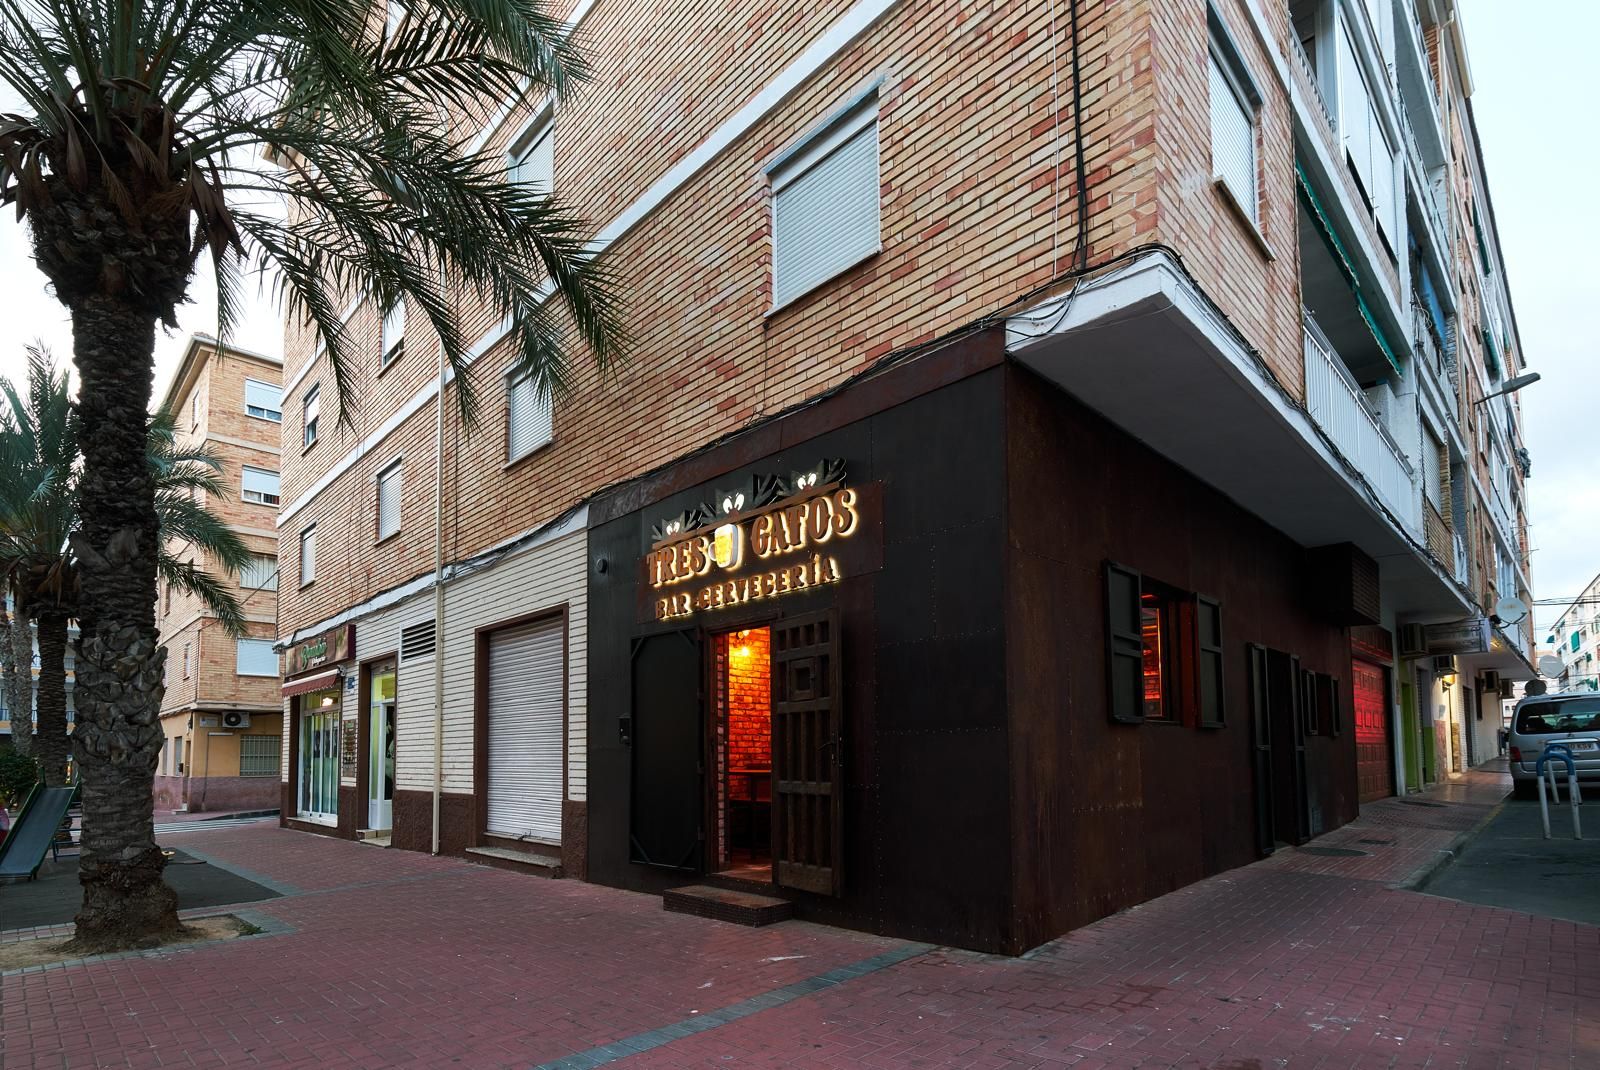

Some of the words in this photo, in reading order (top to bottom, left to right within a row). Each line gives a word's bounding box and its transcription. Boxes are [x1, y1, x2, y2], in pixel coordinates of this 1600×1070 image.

[646, 535, 708, 586] TRES
[751, 488, 854, 556] GATOS
[655, 593, 690, 620] BAR
